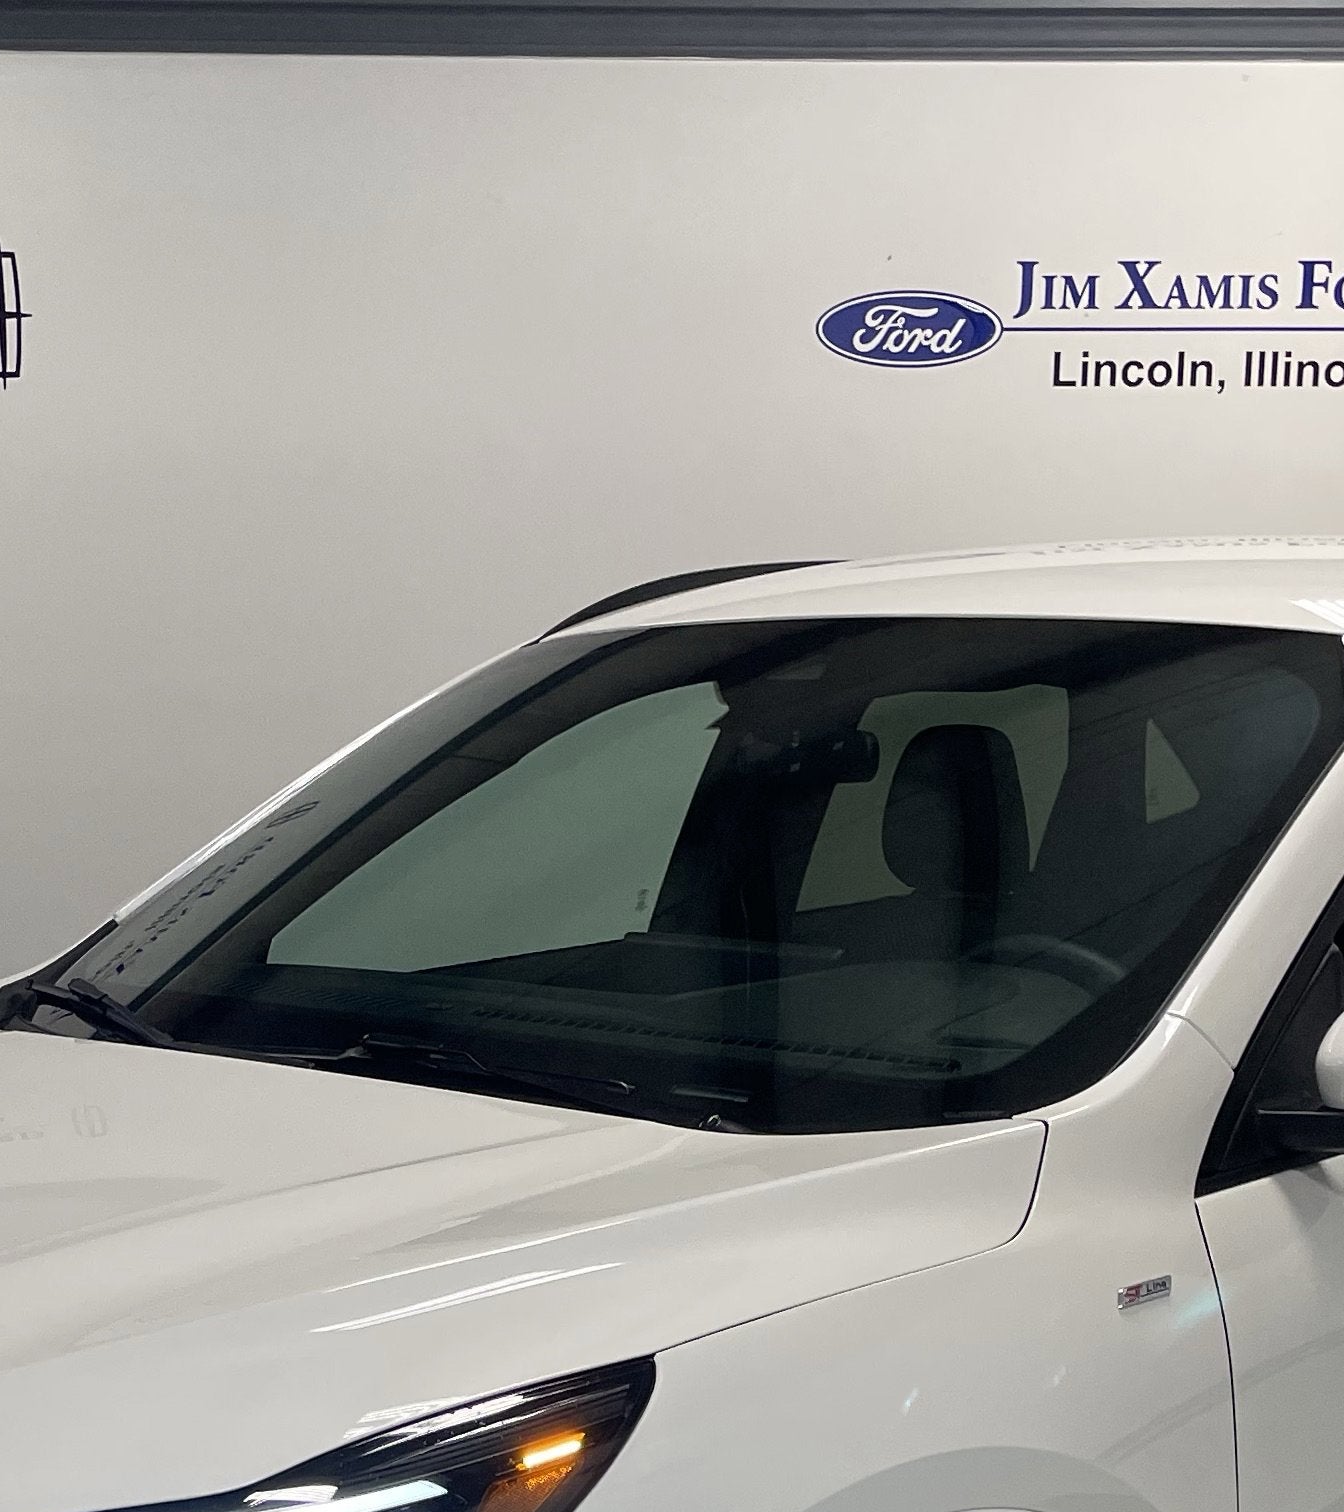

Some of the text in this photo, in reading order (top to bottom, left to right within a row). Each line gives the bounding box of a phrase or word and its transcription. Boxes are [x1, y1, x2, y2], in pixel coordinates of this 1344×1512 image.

[1012, 260, 1100, 319] JIM
[1114, 260, 1279, 311] XAMIS
[852, 304, 968, 354] Ford
[1052, 351, 1225, 394] Lincoln,
